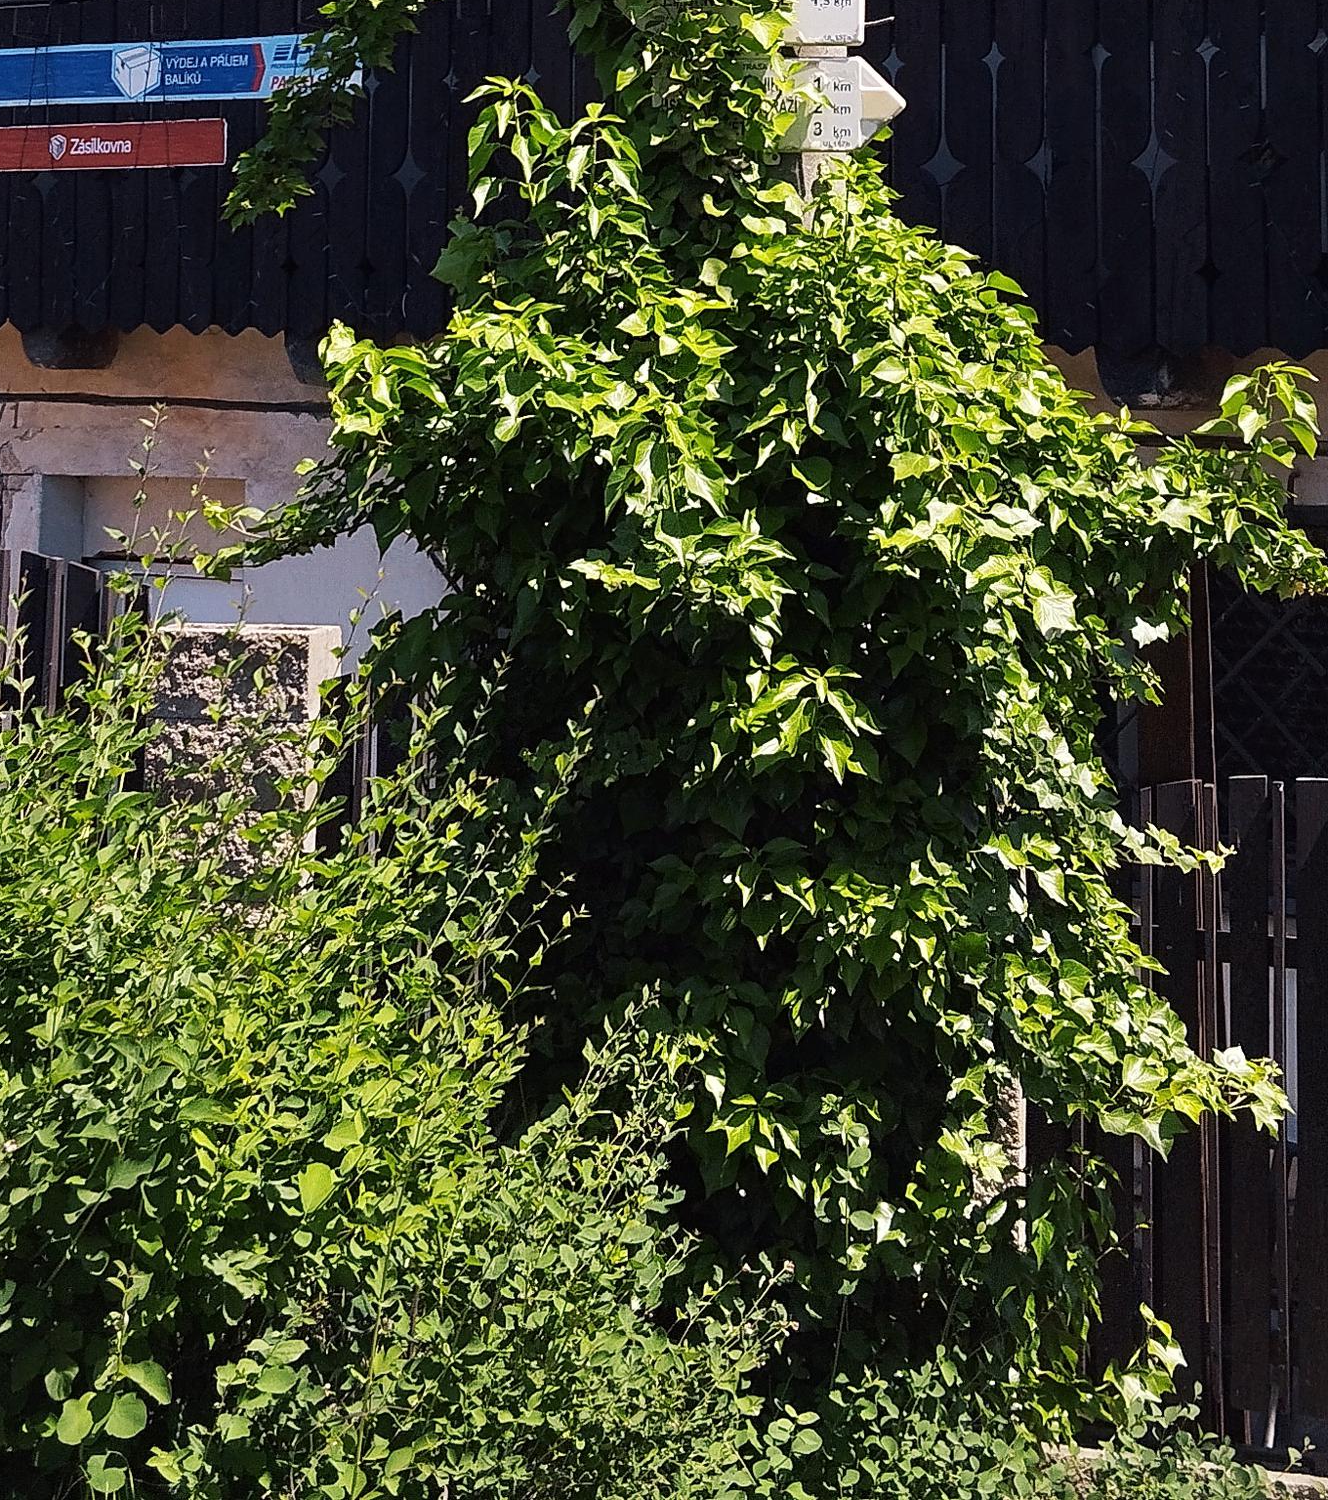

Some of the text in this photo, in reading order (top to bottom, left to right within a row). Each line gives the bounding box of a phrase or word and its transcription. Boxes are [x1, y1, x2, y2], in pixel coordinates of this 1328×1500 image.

[165, 53, 249, 69] VÝDEJ A PŘÍJEM
[164, 70, 202, 86] BALÍKŮ
[813, 76, 852, 92] 1 km
[833, 103, 852, 115] km
[813, 122, 852, 137] 3 km
[69, 137, 132, 155] Zásilkovna
